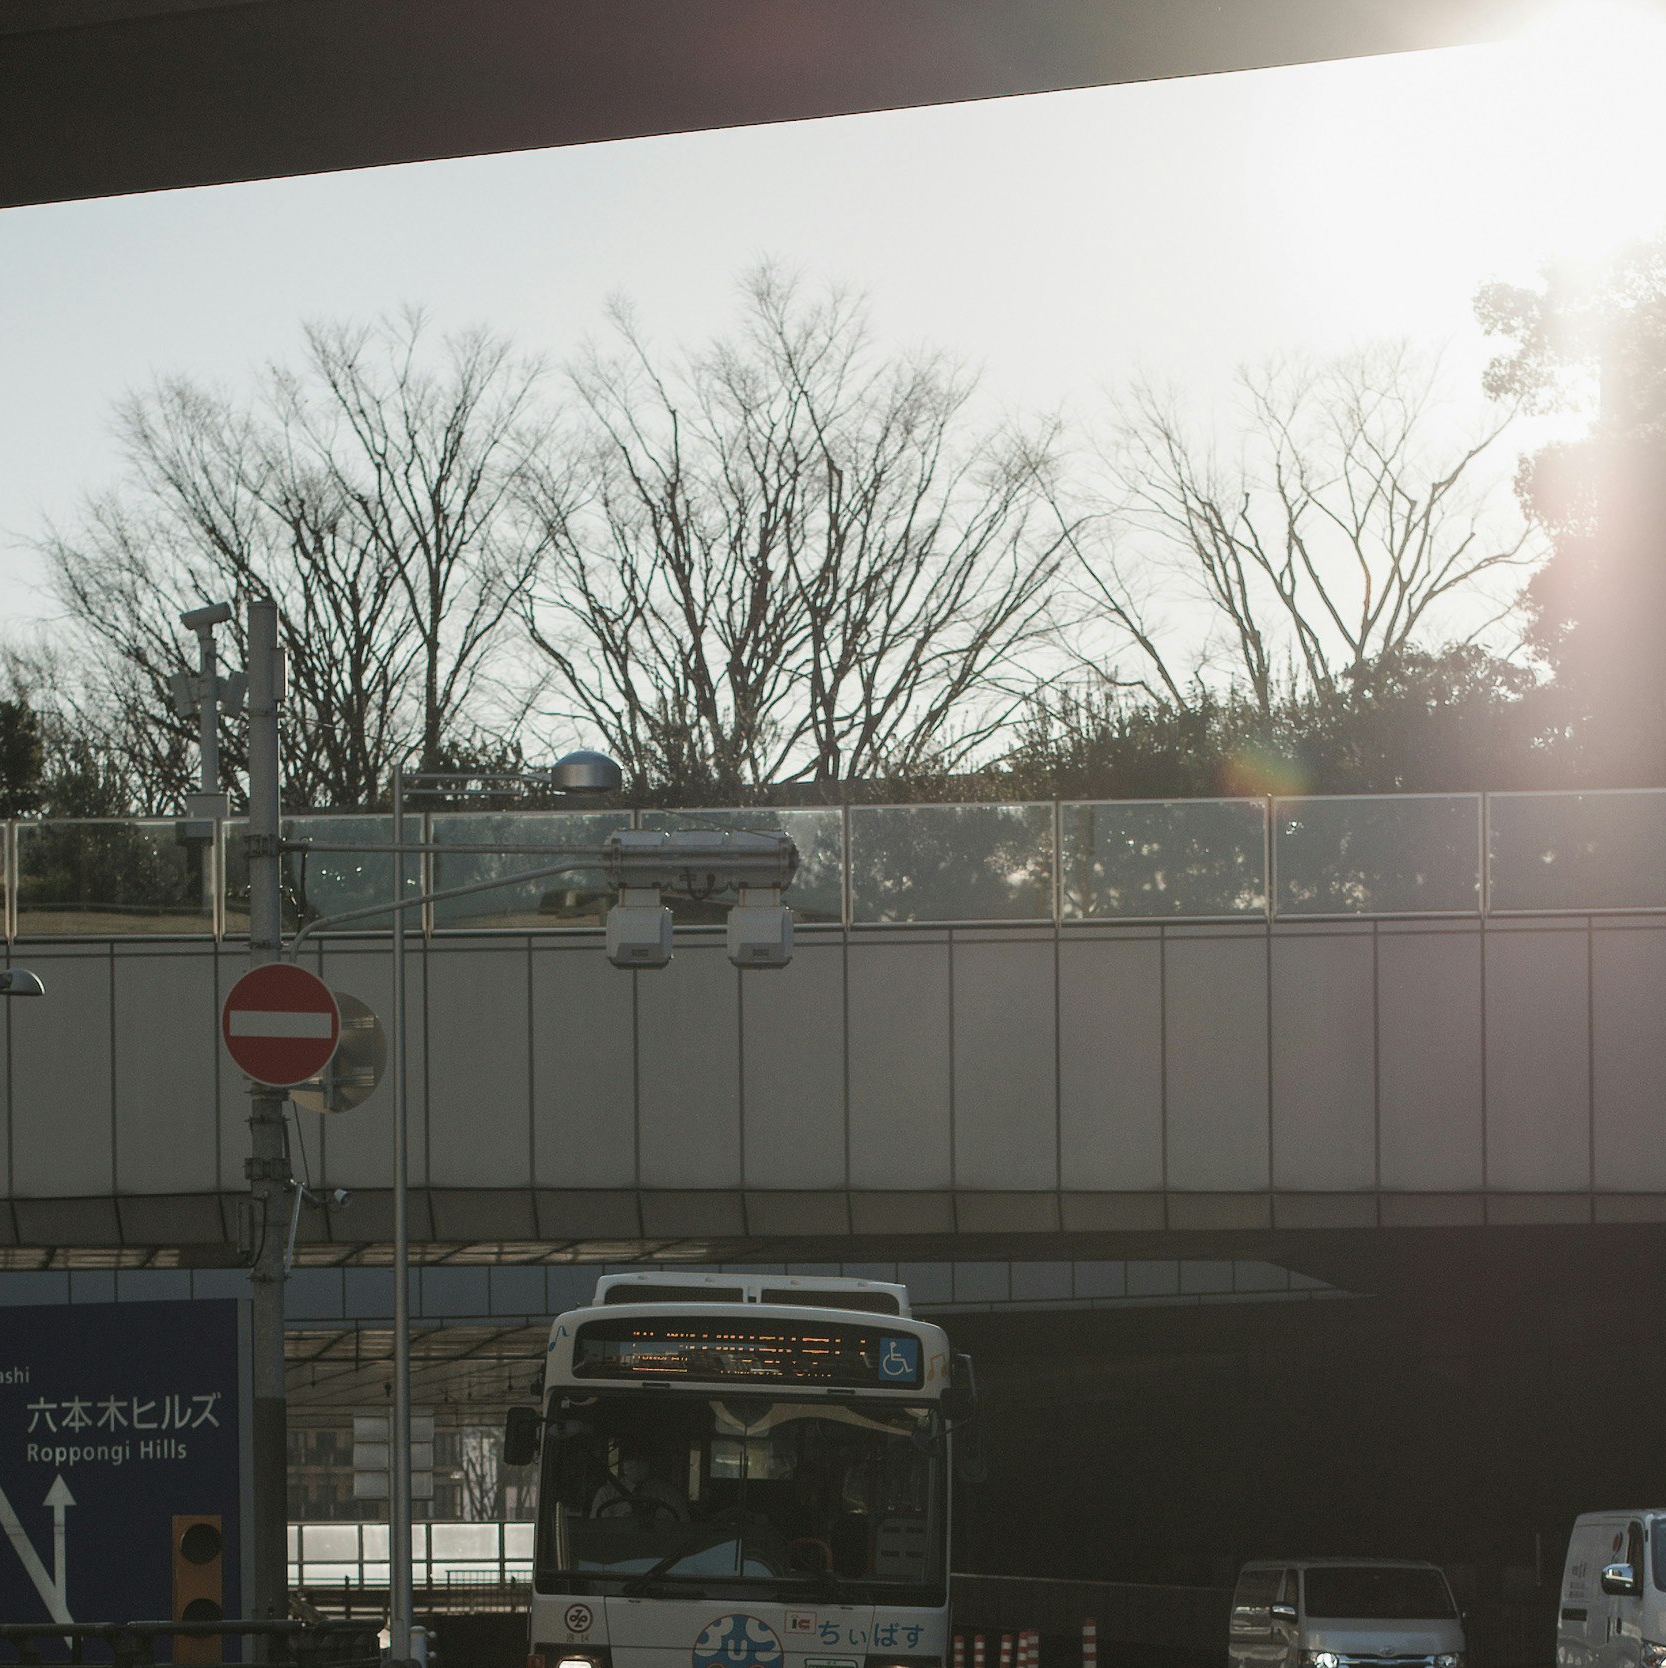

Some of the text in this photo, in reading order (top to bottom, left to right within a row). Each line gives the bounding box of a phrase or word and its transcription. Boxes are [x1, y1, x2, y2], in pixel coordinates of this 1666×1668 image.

[26, 1391, 222, 1434] 六本木ヒルズ
[27, 1439, 188, 1467] Roppongi Hills
